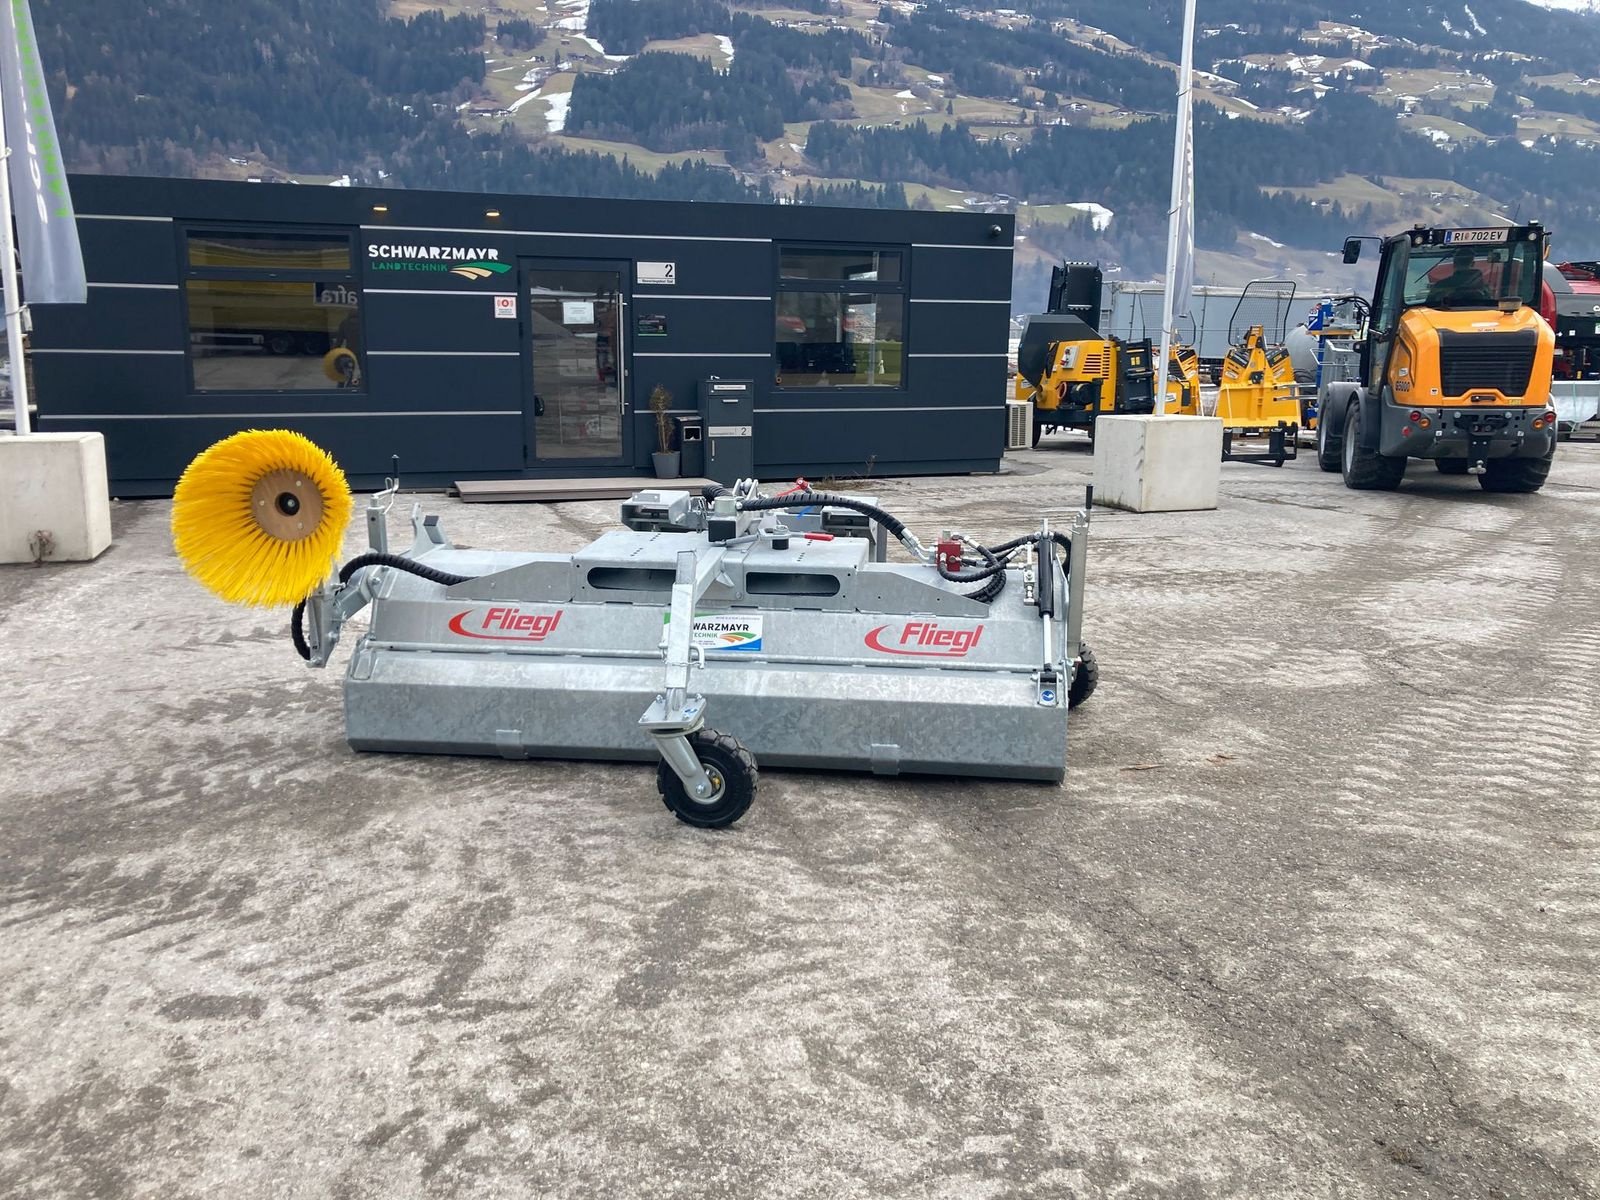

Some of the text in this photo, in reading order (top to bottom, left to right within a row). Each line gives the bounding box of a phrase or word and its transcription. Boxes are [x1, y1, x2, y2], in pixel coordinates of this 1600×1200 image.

[1454, 232, 1464, 241] RI
[368, 244, 499, 260] SCHWARZMAYR
[371, 261, 448, 272] LANDTECHNIK
[665, 264, 673, 278] 2
[740, 427, 747, 436] 2
[481, 607, 563, 637] Fliegl
[693, 622, 749, 631] WARZMAYR
[899, 622, 984, 652] Fliegl
